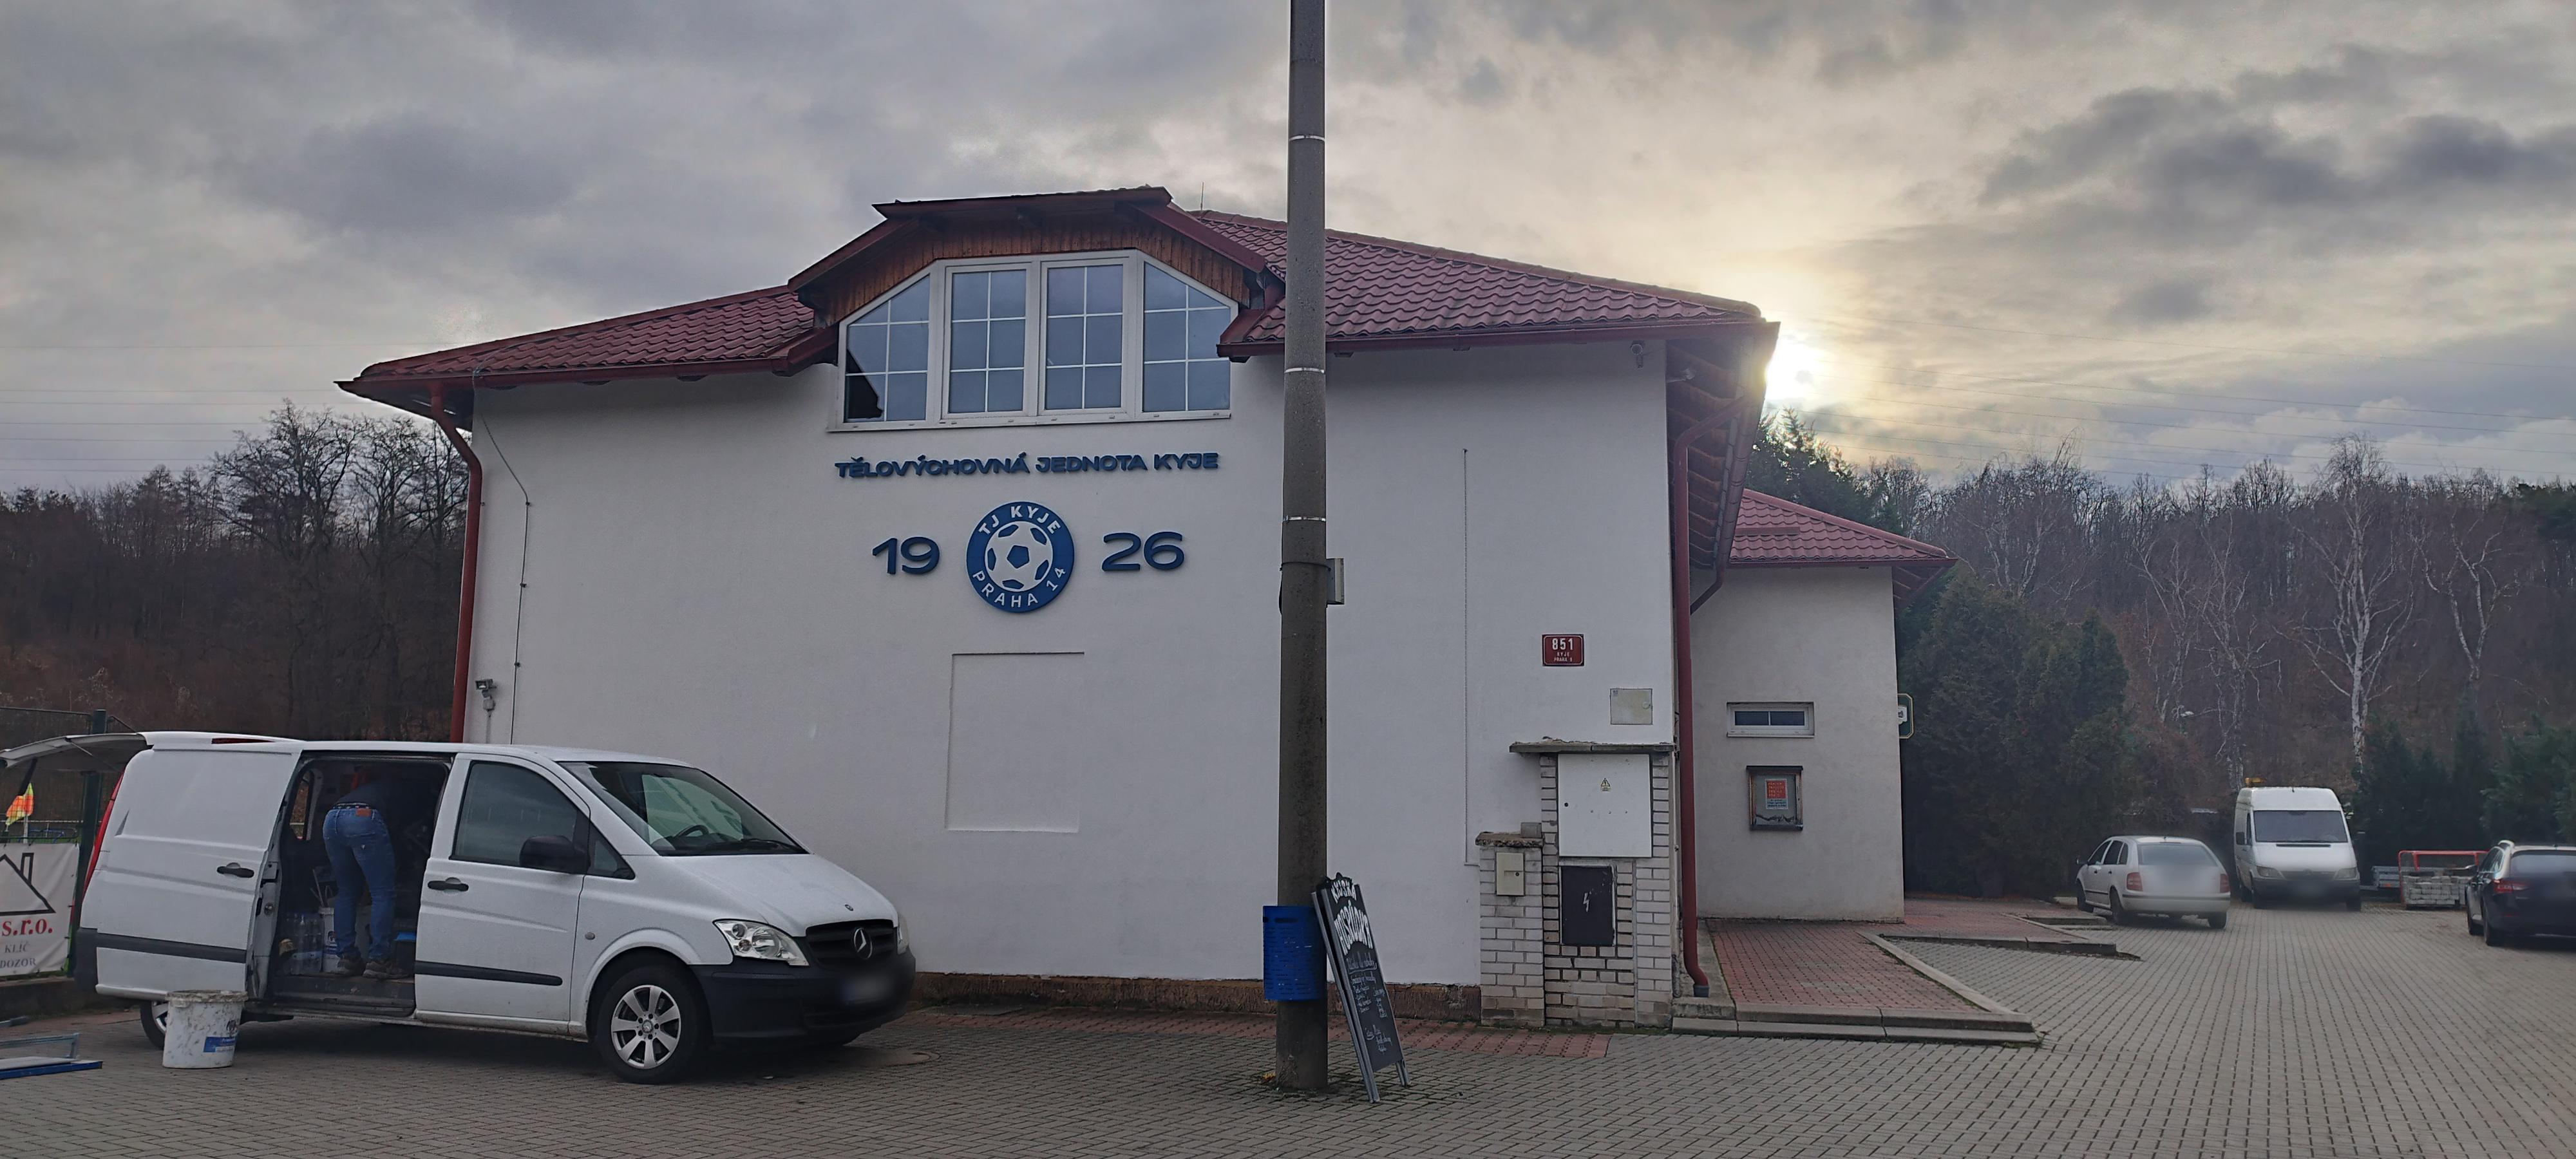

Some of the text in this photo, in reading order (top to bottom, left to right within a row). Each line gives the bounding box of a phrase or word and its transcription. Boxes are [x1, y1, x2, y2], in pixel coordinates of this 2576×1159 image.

[835, 451, 1219, 478] TĚLOVÝCHOVNÁ JEDNOTA KYJE
[978, 505, 1061, 535] TJ KYJE
[872, 531, 1185, 575] 19 26
[972, 567, 1066, 608] PRAHA 14
[1551, 637, 1573, 650] 851
[2, 918, 53, 937] s.r.o.
[0, 957, 37, 969] DOZOR
